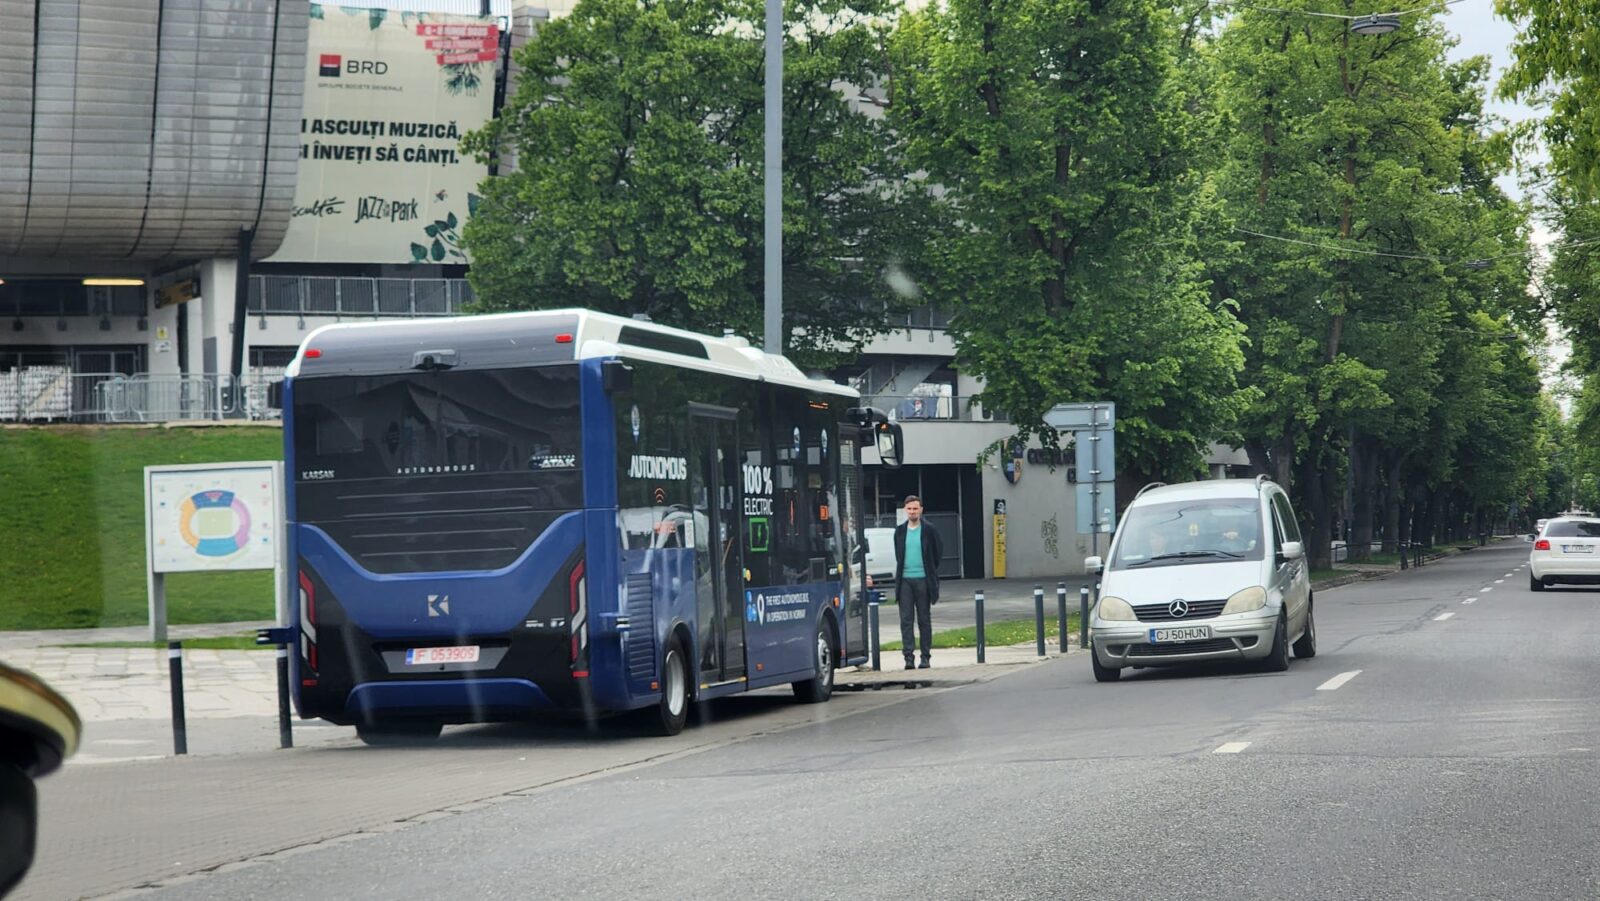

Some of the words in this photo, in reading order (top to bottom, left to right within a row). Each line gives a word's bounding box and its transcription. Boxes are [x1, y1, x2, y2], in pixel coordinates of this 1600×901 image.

[347, 60, 388, 75] BRD
[311, 119, 384, 140] ASCULȚI
[388, 121, 462, 140] MUZICĂ,
[313, 141, 372, 164] ÎNVEȚI
[375, 144, 399, 162] SĂ
[403, 144, 460, 166] CÂNȚI.
[354, 196, 384, 223] JAZZ
[391, 198, 418, 223] Park
[302, 470, 335, 480] KARSAN
[397, 464, 475, 474] AUTONOMOUS
[630, 454, 687, 480] AUTONOMOUS
[742, 464, 762, 494] 100
[762, 466, 773, 495] %
[744, 498, 774, 515] ELECTRIC
[1156, 630, 1168, 640] CJ
[432, 648, 474, 660] 053909
